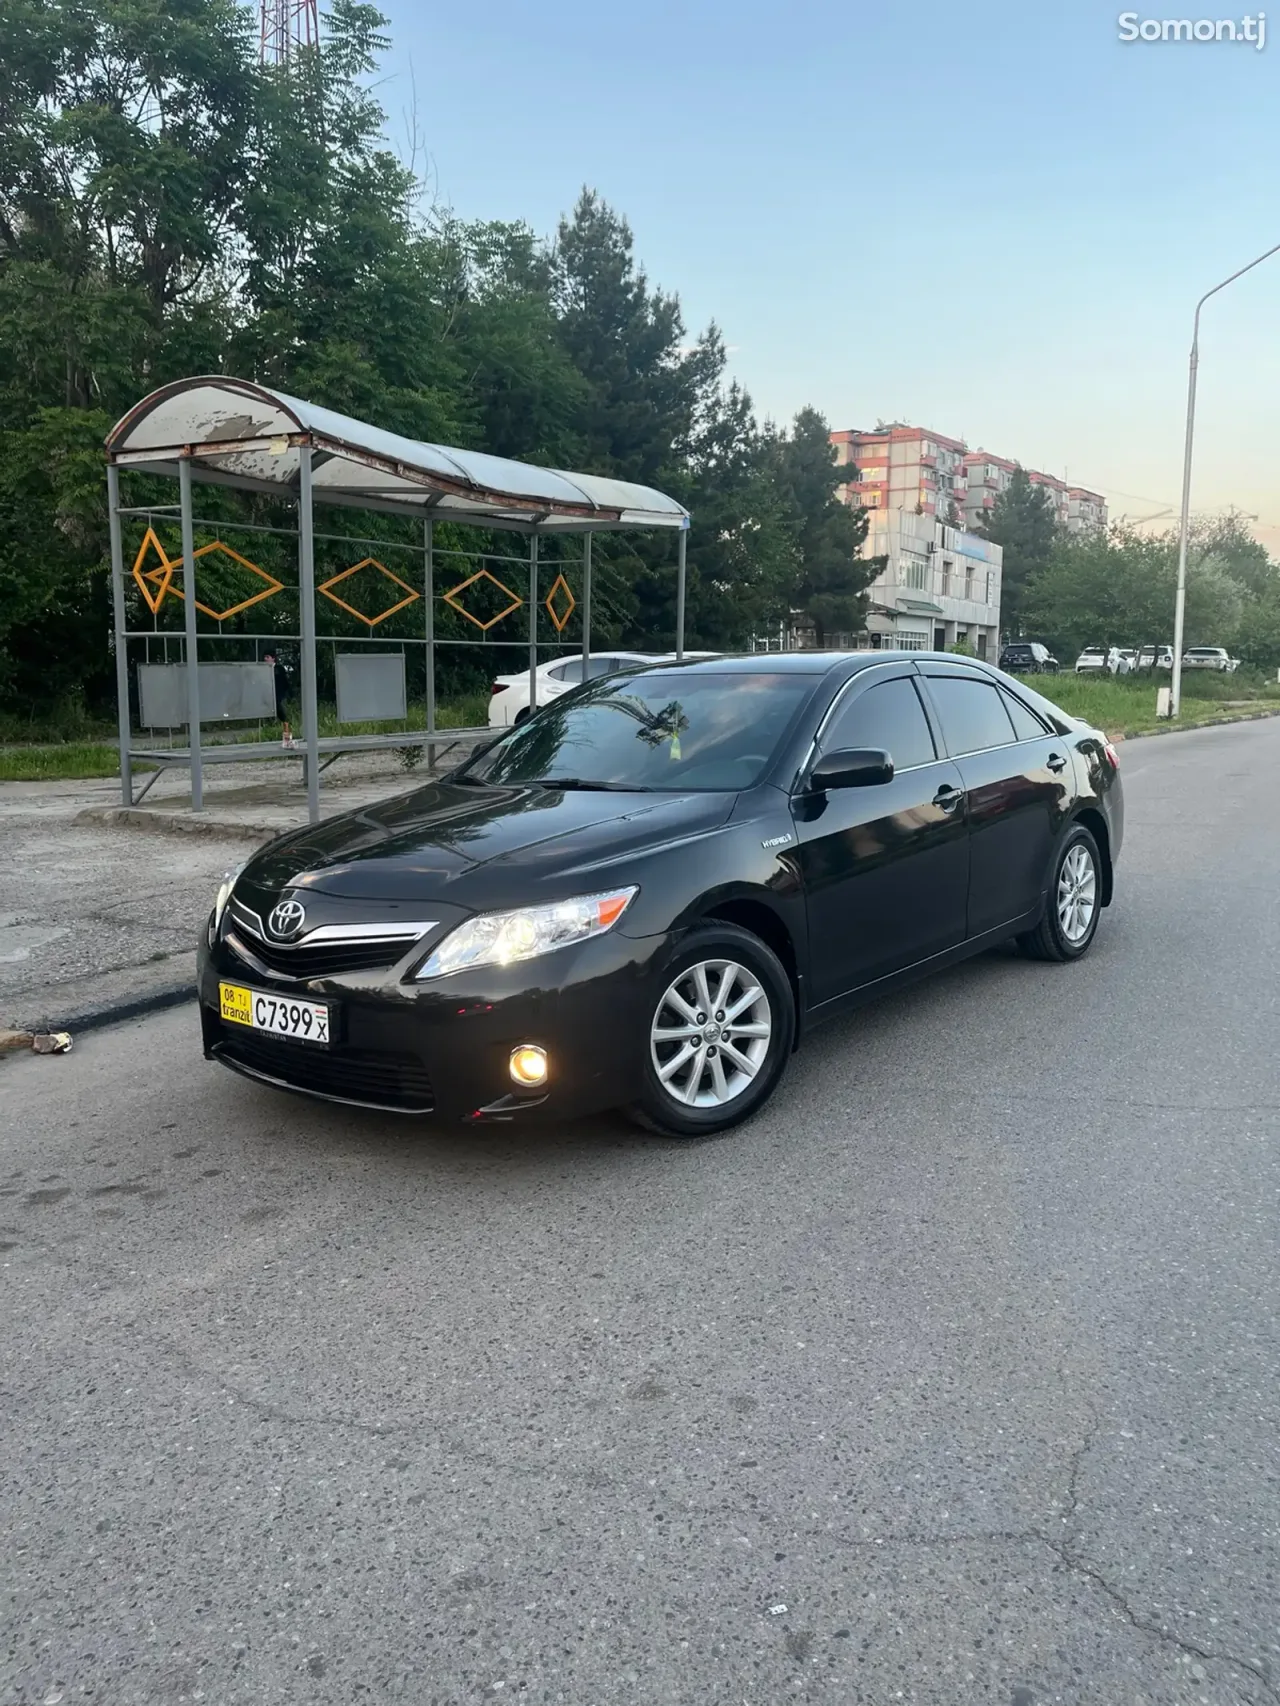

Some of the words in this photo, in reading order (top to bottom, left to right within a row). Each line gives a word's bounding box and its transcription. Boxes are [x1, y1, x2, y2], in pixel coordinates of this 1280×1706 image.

[761, 835, 789, 849] HYBRID
[224, 988, 235, 1003] 08
[238, 993, 246, 1006] TJ
[222, 1003, 251, 1023] tranzit
[255, 997, 312, 1035] C7399
[317, 1021, 327, 1040] X
